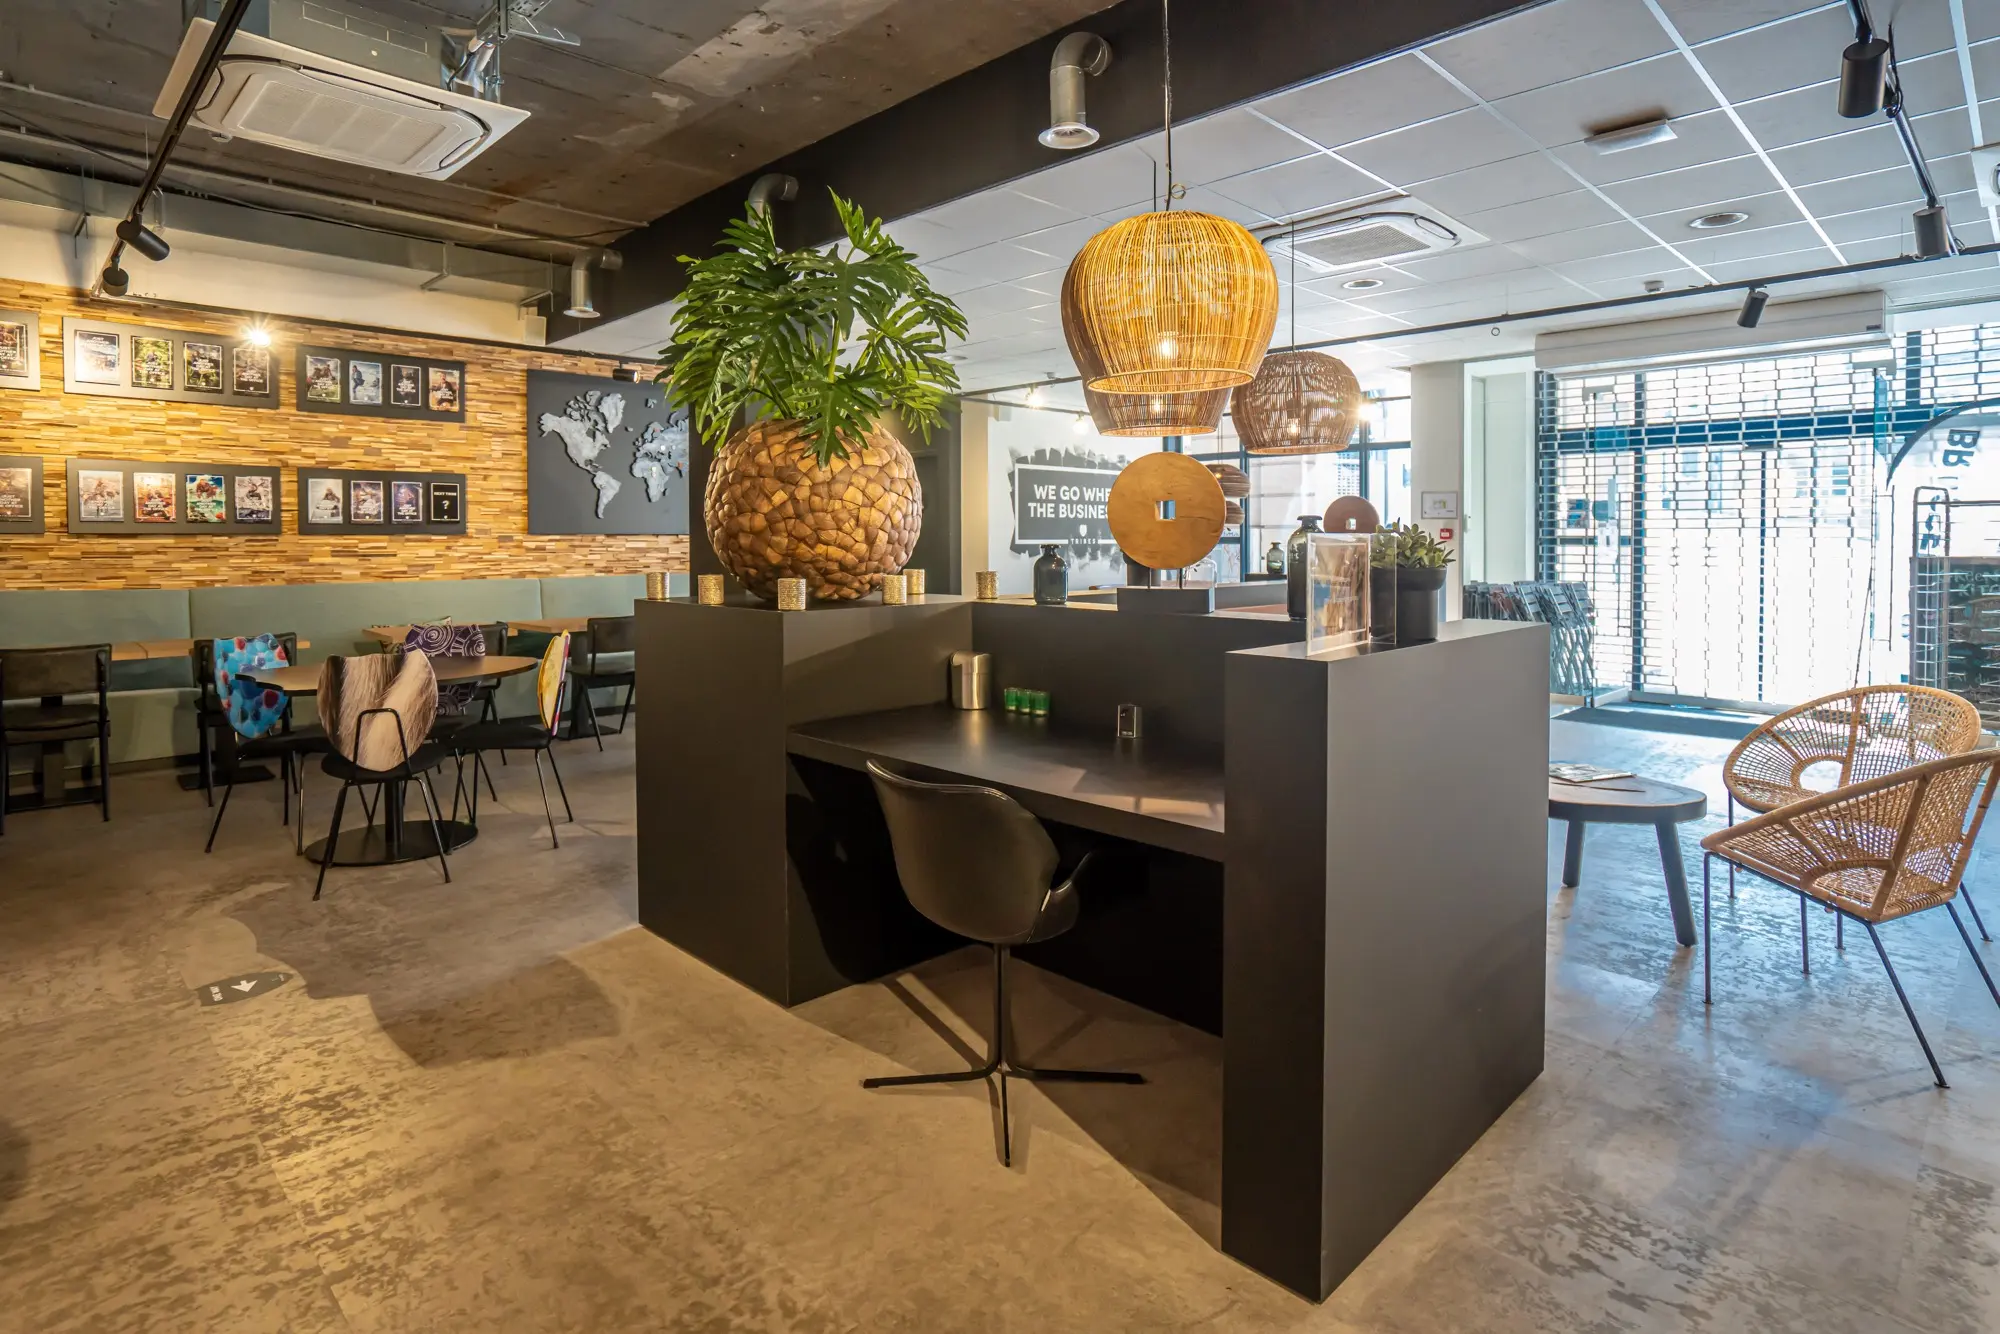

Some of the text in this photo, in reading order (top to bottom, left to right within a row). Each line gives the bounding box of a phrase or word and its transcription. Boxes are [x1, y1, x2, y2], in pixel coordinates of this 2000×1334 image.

[1034, 484, 1111, 502] WE GO WHE
[1028, 502, 1108, 519] THE BUSINE
